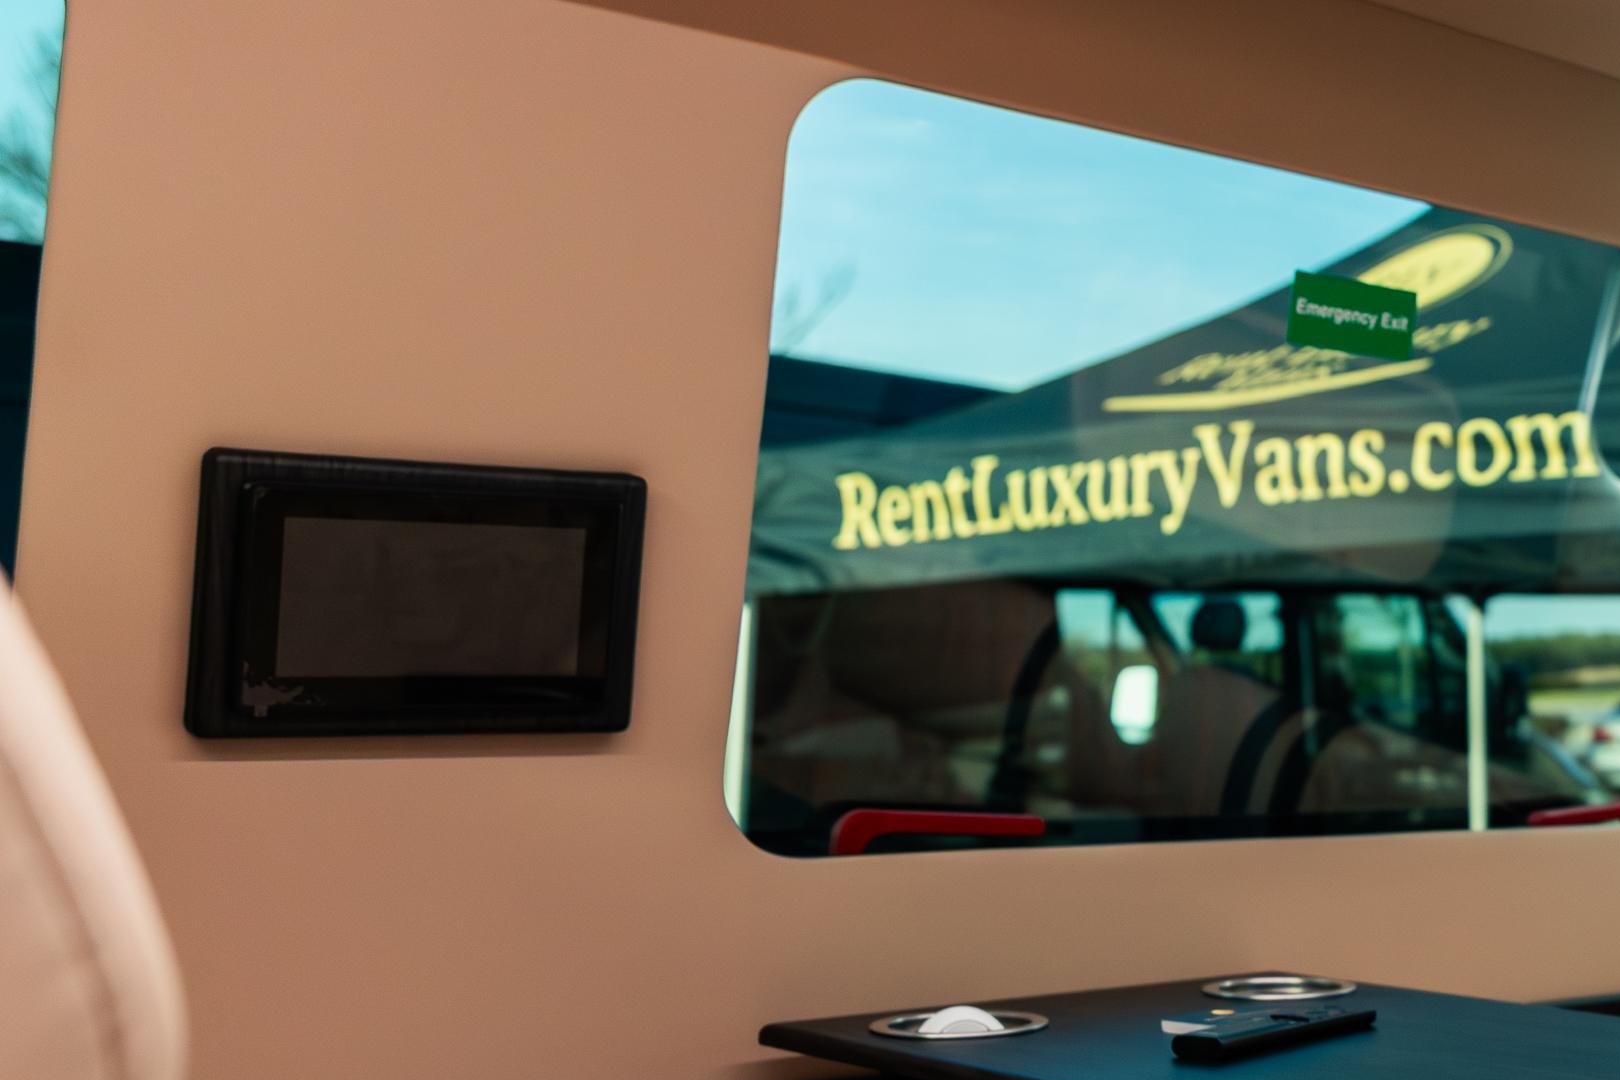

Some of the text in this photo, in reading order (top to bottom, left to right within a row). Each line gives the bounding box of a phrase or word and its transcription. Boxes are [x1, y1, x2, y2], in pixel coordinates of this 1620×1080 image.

[1296, 296, 1409, 332] Emergency Exit
[832, 410, 1600, 549] RentLuxuryVans.com
